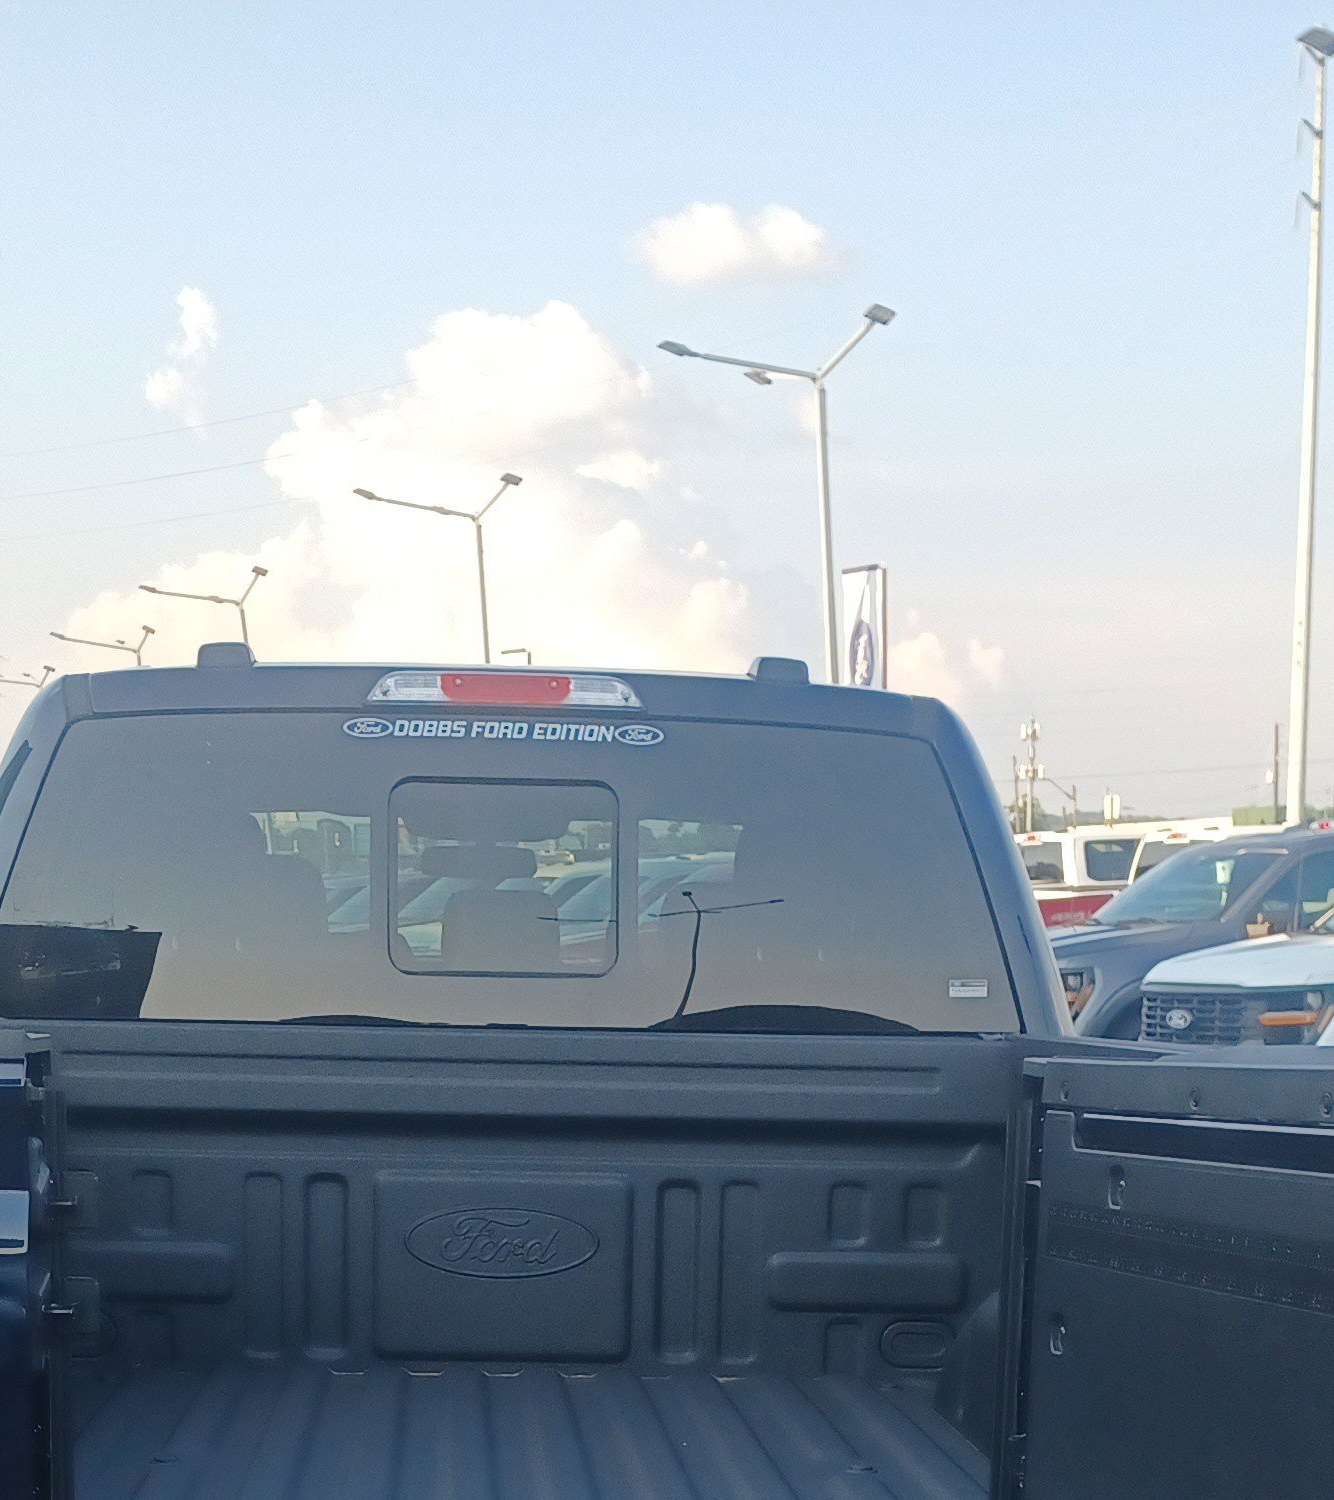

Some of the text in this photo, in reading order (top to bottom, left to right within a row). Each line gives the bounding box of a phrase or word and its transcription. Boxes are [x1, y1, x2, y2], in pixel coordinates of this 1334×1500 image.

[393, 719, 467, 738] DOBBS
[471, 721, 529, 739] FORD
[533, 723, 615, 742] EDITION
[441, 1216, 562, 1265] Ford
